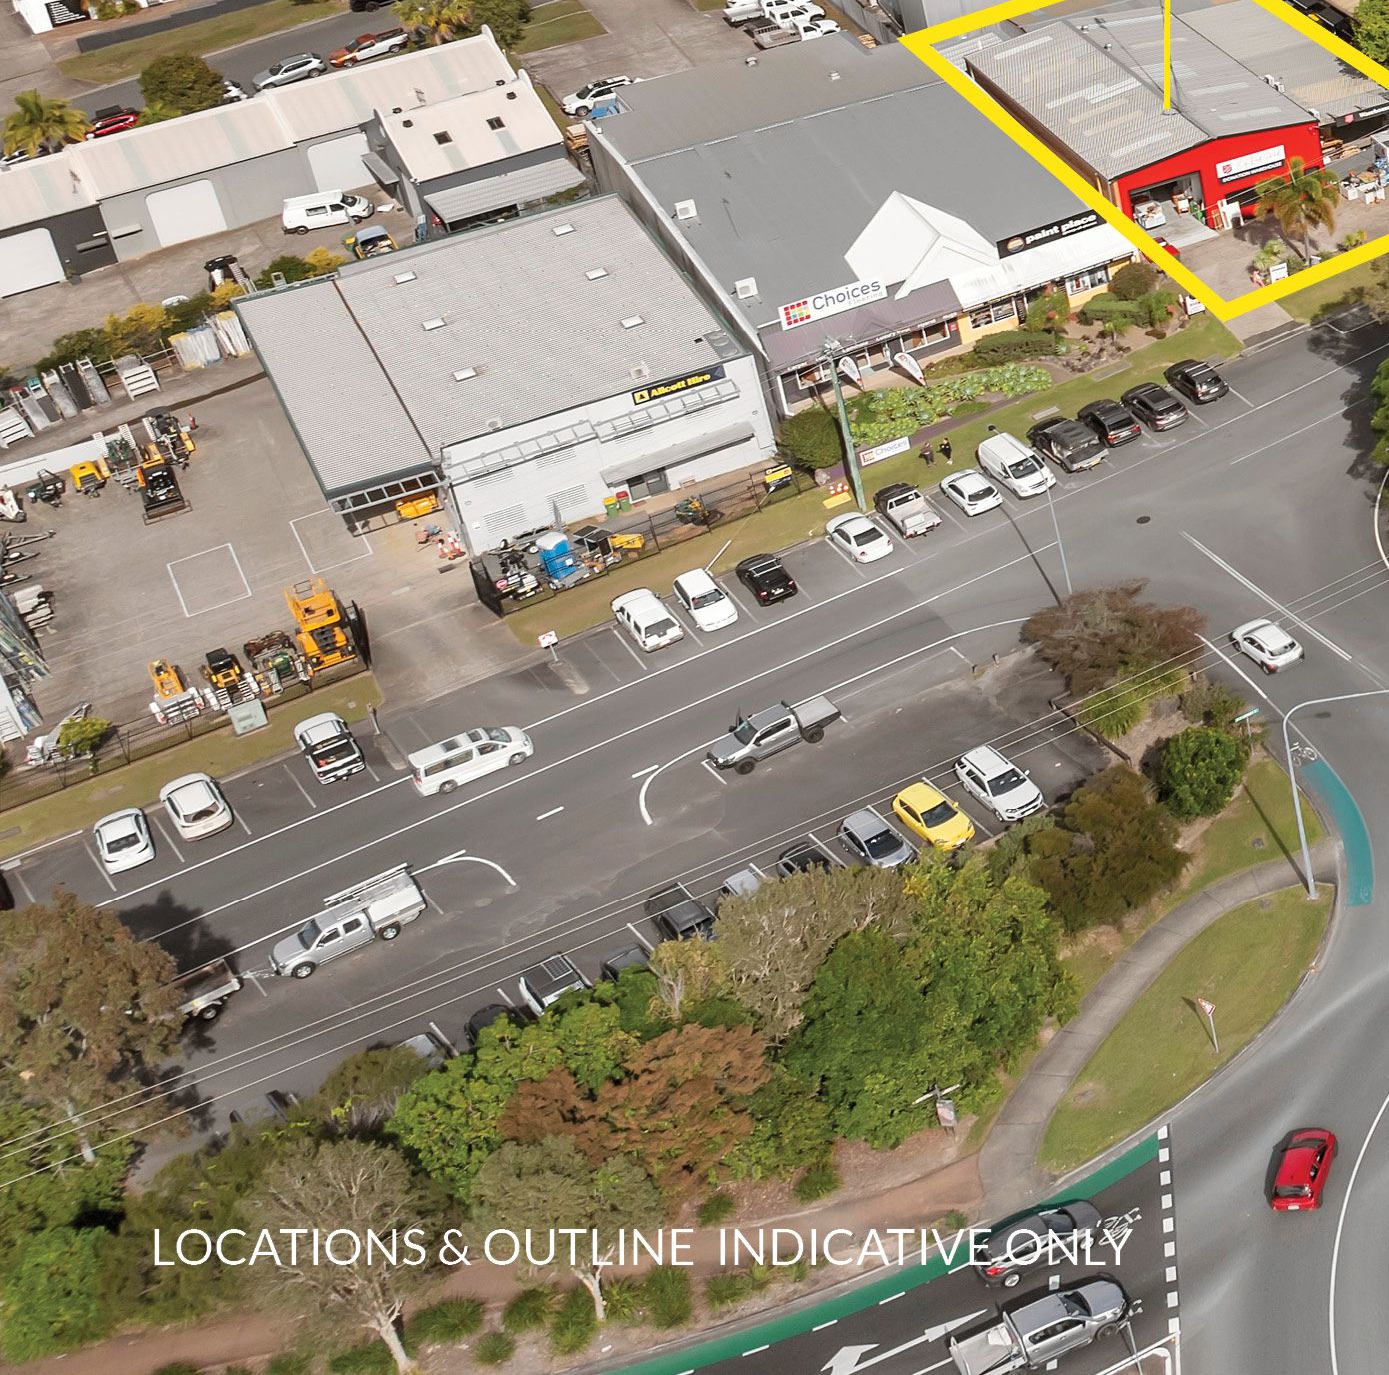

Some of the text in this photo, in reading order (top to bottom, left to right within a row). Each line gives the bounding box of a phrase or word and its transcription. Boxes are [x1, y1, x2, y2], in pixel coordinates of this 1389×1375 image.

[1025, 225, 1060, 245] paint
[1060, 214, 1098, 232] place
[812, 278, 881, 311] Choices
[650, 373, 711, 398] Allcott Hire
[875, 439, 908, 456] Choices
